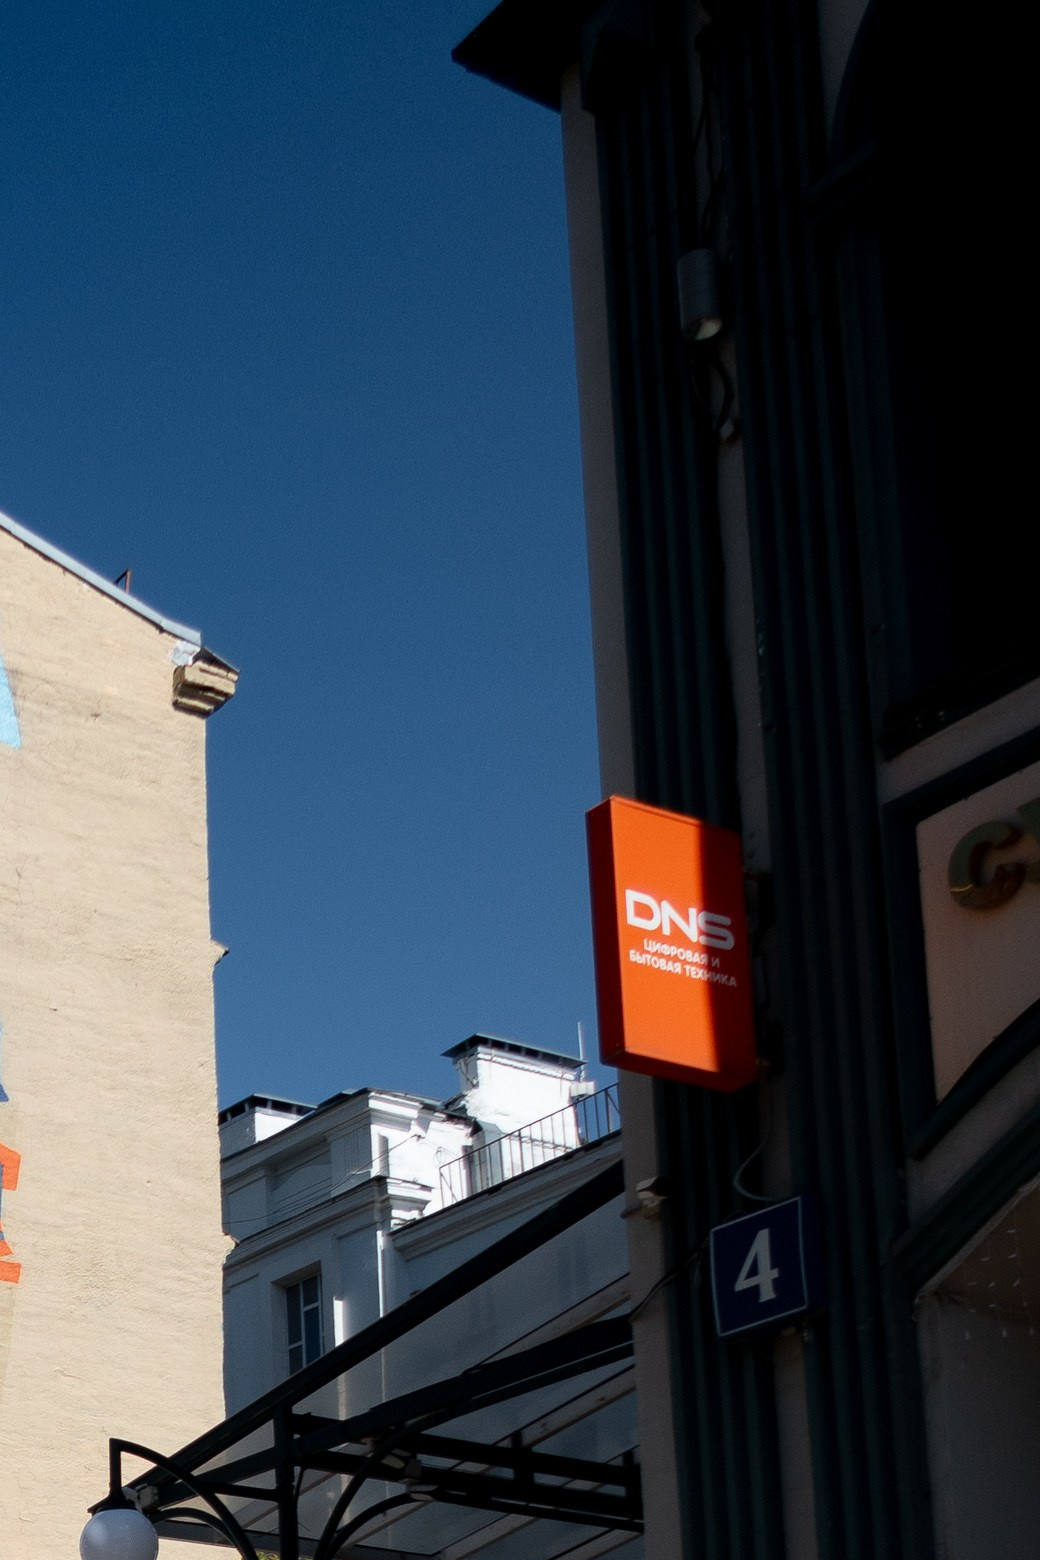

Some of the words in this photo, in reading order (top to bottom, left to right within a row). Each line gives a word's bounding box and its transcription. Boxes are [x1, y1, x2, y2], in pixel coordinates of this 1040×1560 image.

[625, 889, 736, 951] DNS
[629, 949, 682, 975] БЫТОВАЯ
[684, 964, 738, 988] ТЕХНИКА
[643, 938, 708, 966] ЦИФРОВАЯ
[711, 955, 721, 969] И
[734, 1227, 779, 1304] 4
